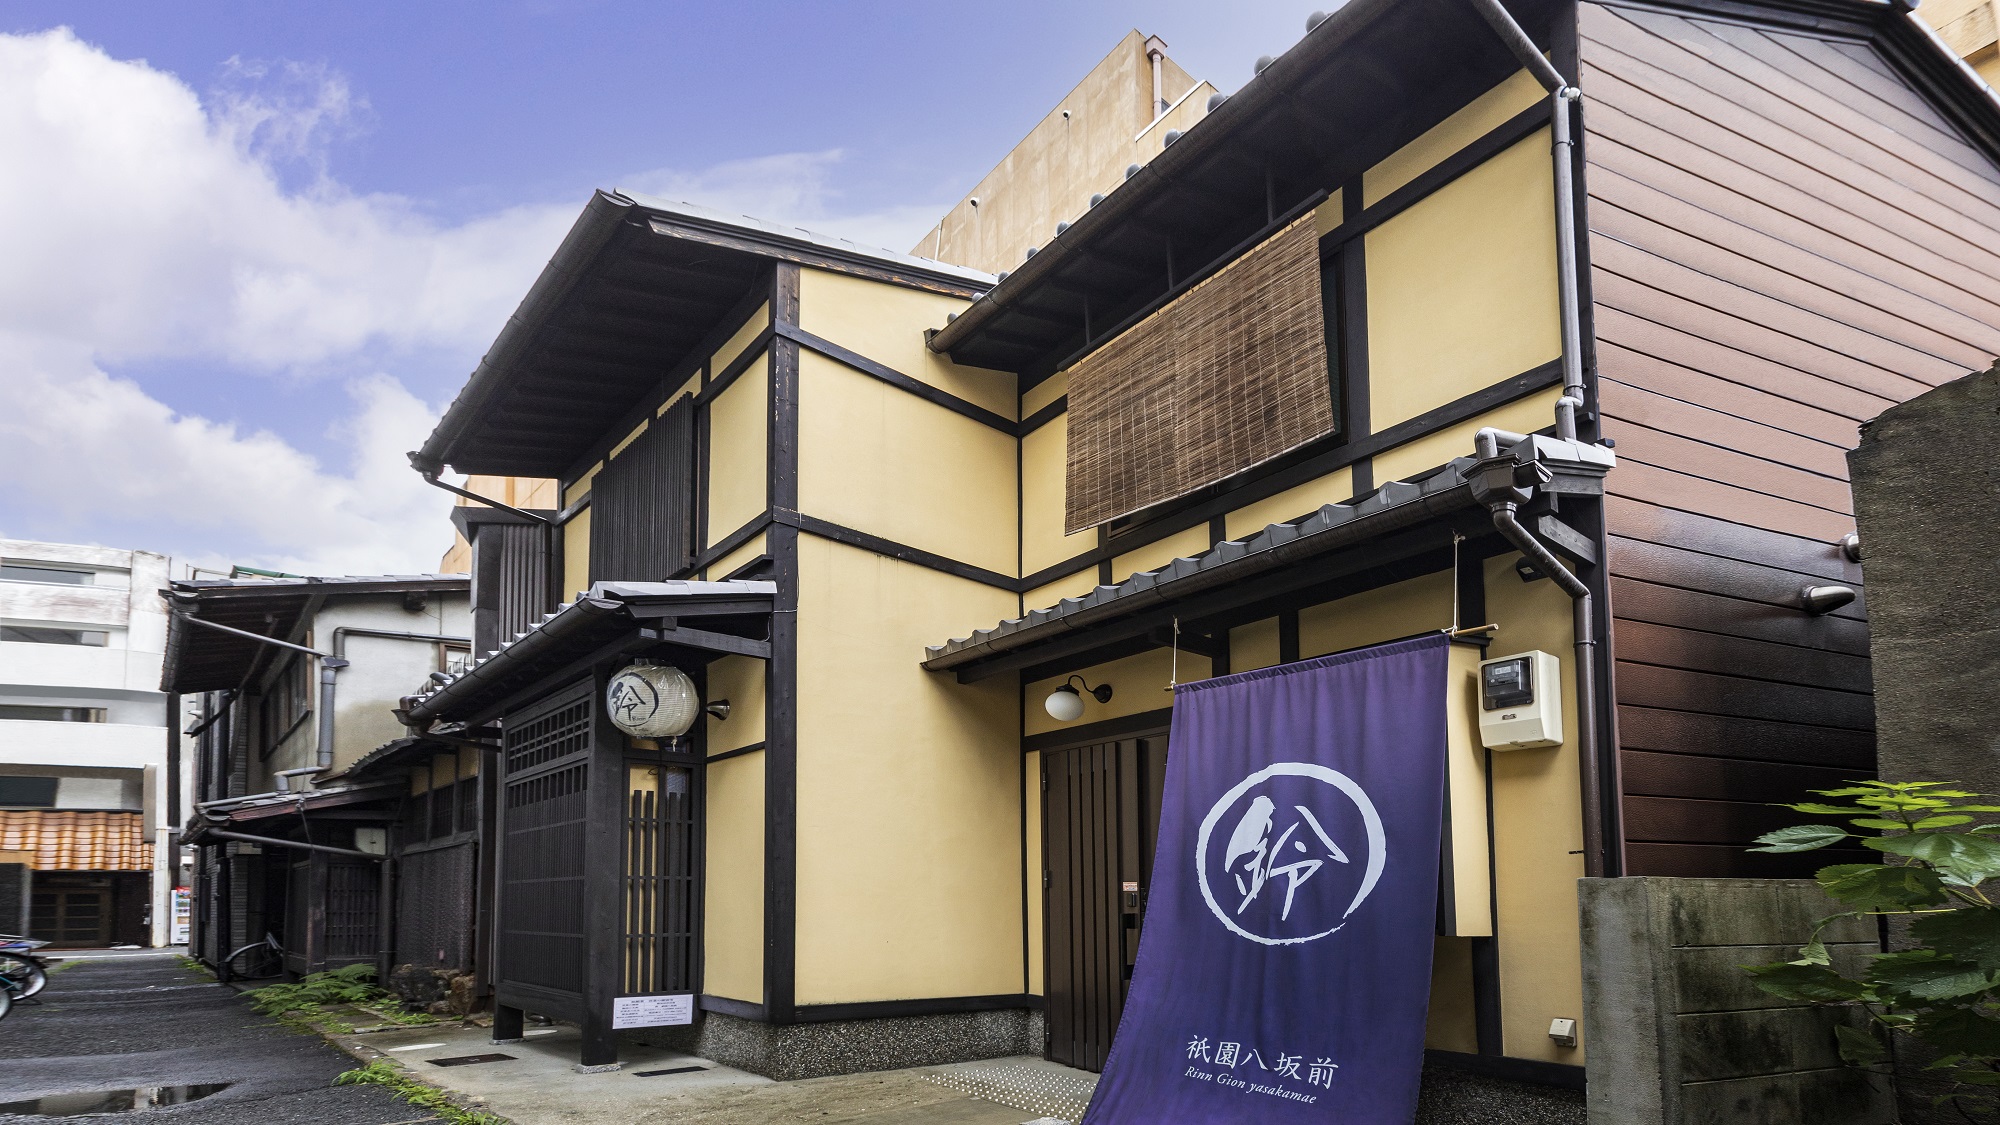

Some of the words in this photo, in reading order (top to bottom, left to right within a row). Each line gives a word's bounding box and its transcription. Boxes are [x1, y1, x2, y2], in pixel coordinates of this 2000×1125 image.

[1184, 1066, 1213, 1081] Rinn
[1217, 1073, 1246, 1089] Gion
[1246, 1083, 1317, 1104] yasakamae
